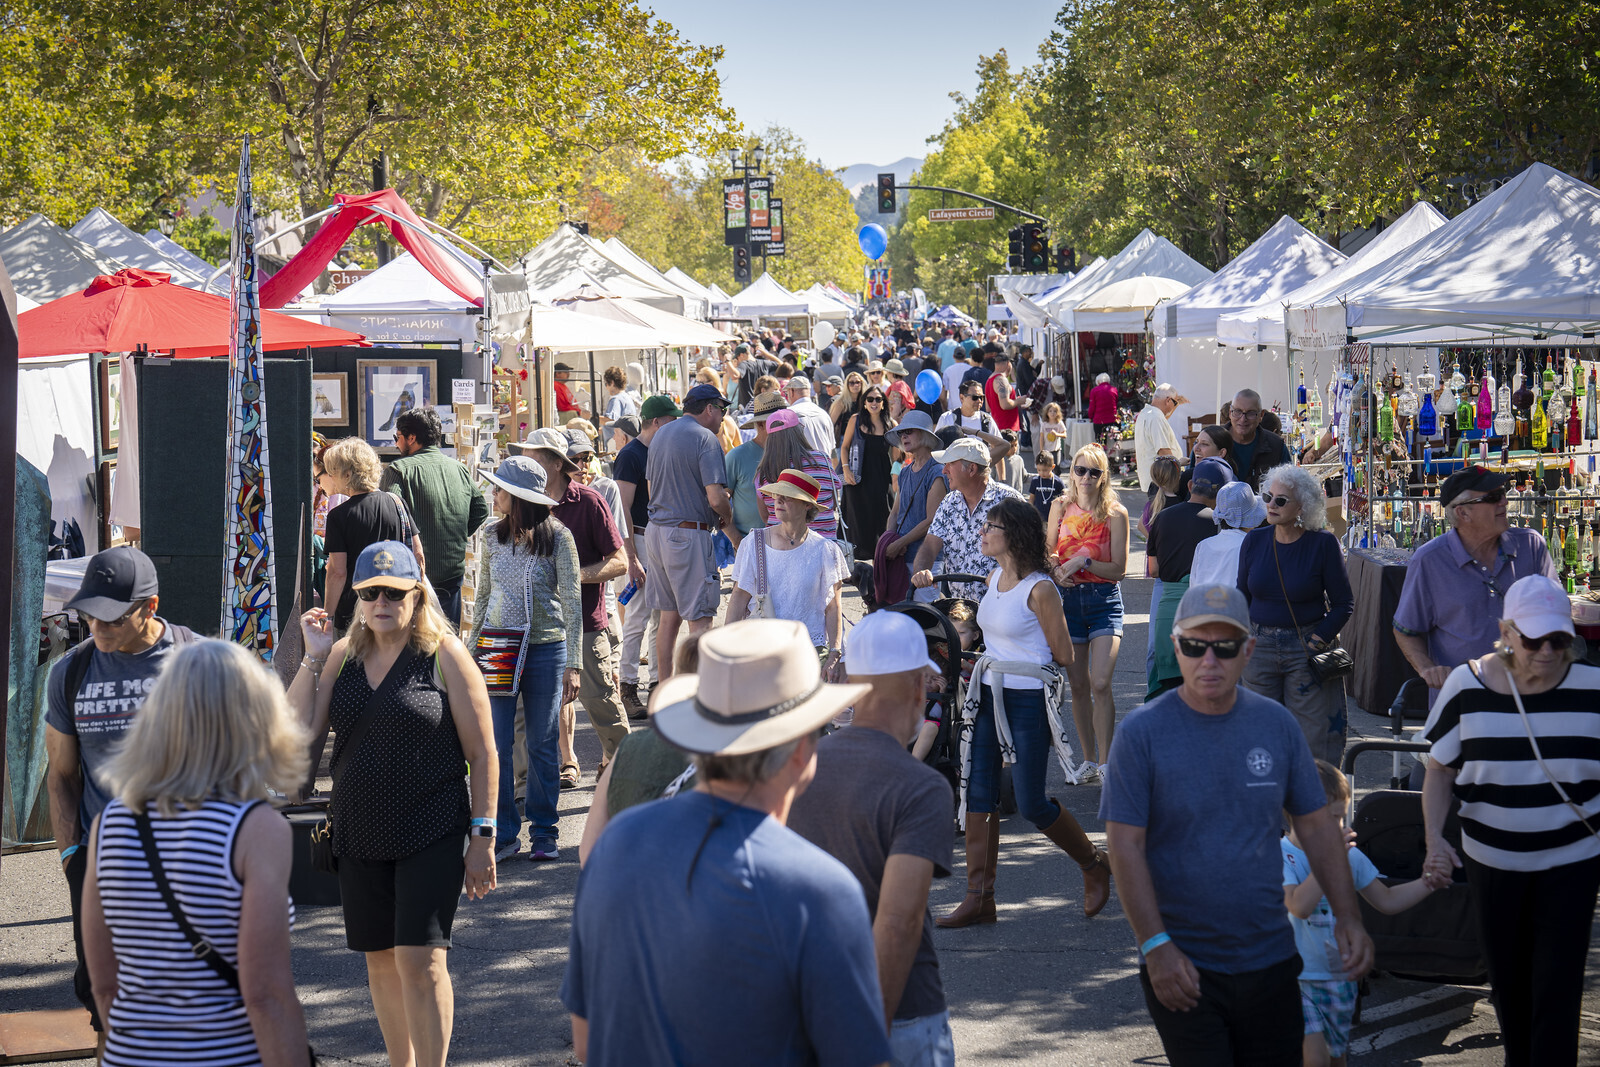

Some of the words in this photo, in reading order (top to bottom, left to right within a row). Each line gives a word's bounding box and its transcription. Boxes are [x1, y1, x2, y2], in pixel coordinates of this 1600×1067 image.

[931, 210, 967, 219] Lafayette
[968, 209, 993, 217] Circle
[453, 380, 474, 388] Cards
[76, 681, 116, 699] LIFE
[122, 677, 156, 695] MO
[74, 696, 146, 715] PRETTY
